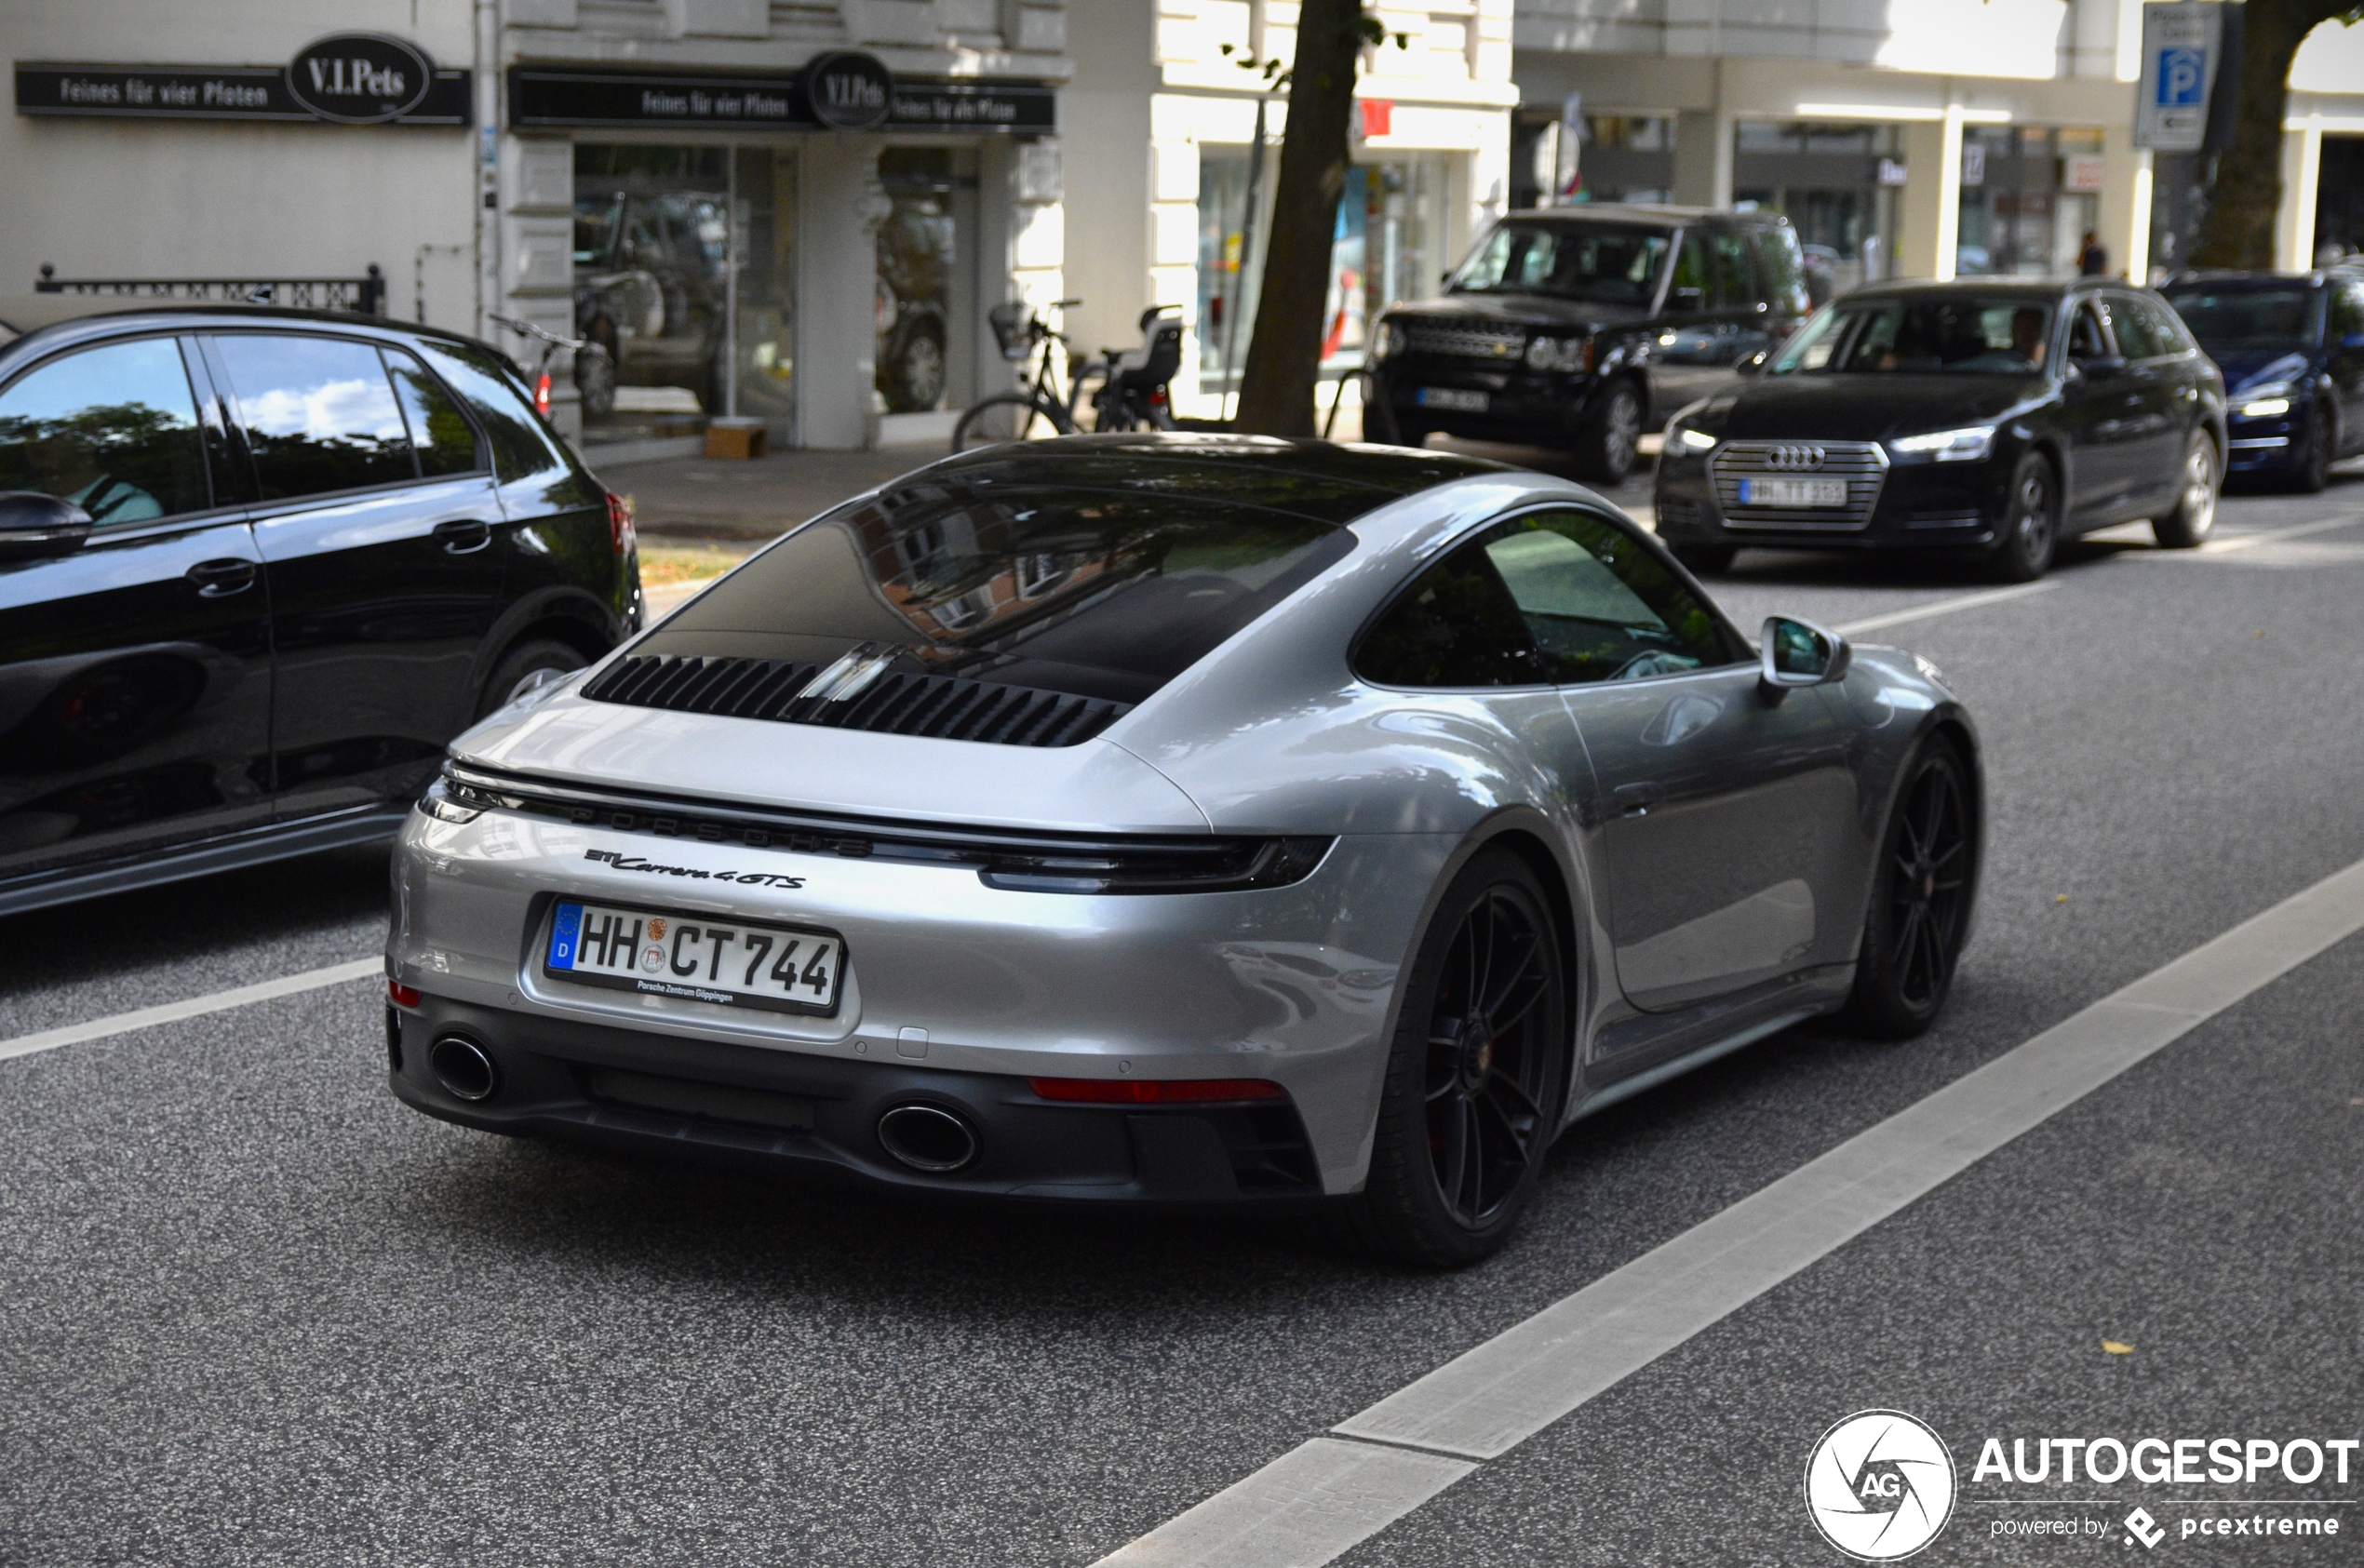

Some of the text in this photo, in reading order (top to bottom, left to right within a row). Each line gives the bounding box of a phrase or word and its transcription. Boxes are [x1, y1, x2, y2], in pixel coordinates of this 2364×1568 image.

[60, 77, 268, 107] Feines für vier Pfoten
[308, 57, 406, 97] V.I.Pets
[571, 807, 873, 858] PORSCHE
[611, 857, 710, 879] Carrera
[713, 870, 738, 881] 4
[736, 873, 807, 889] GTS
[557, 942, 569, 958] D
[578, 913, 831, 996] HH CT 744
[637, 980, 733, 1002] Porsche Zentrum Göppingen
